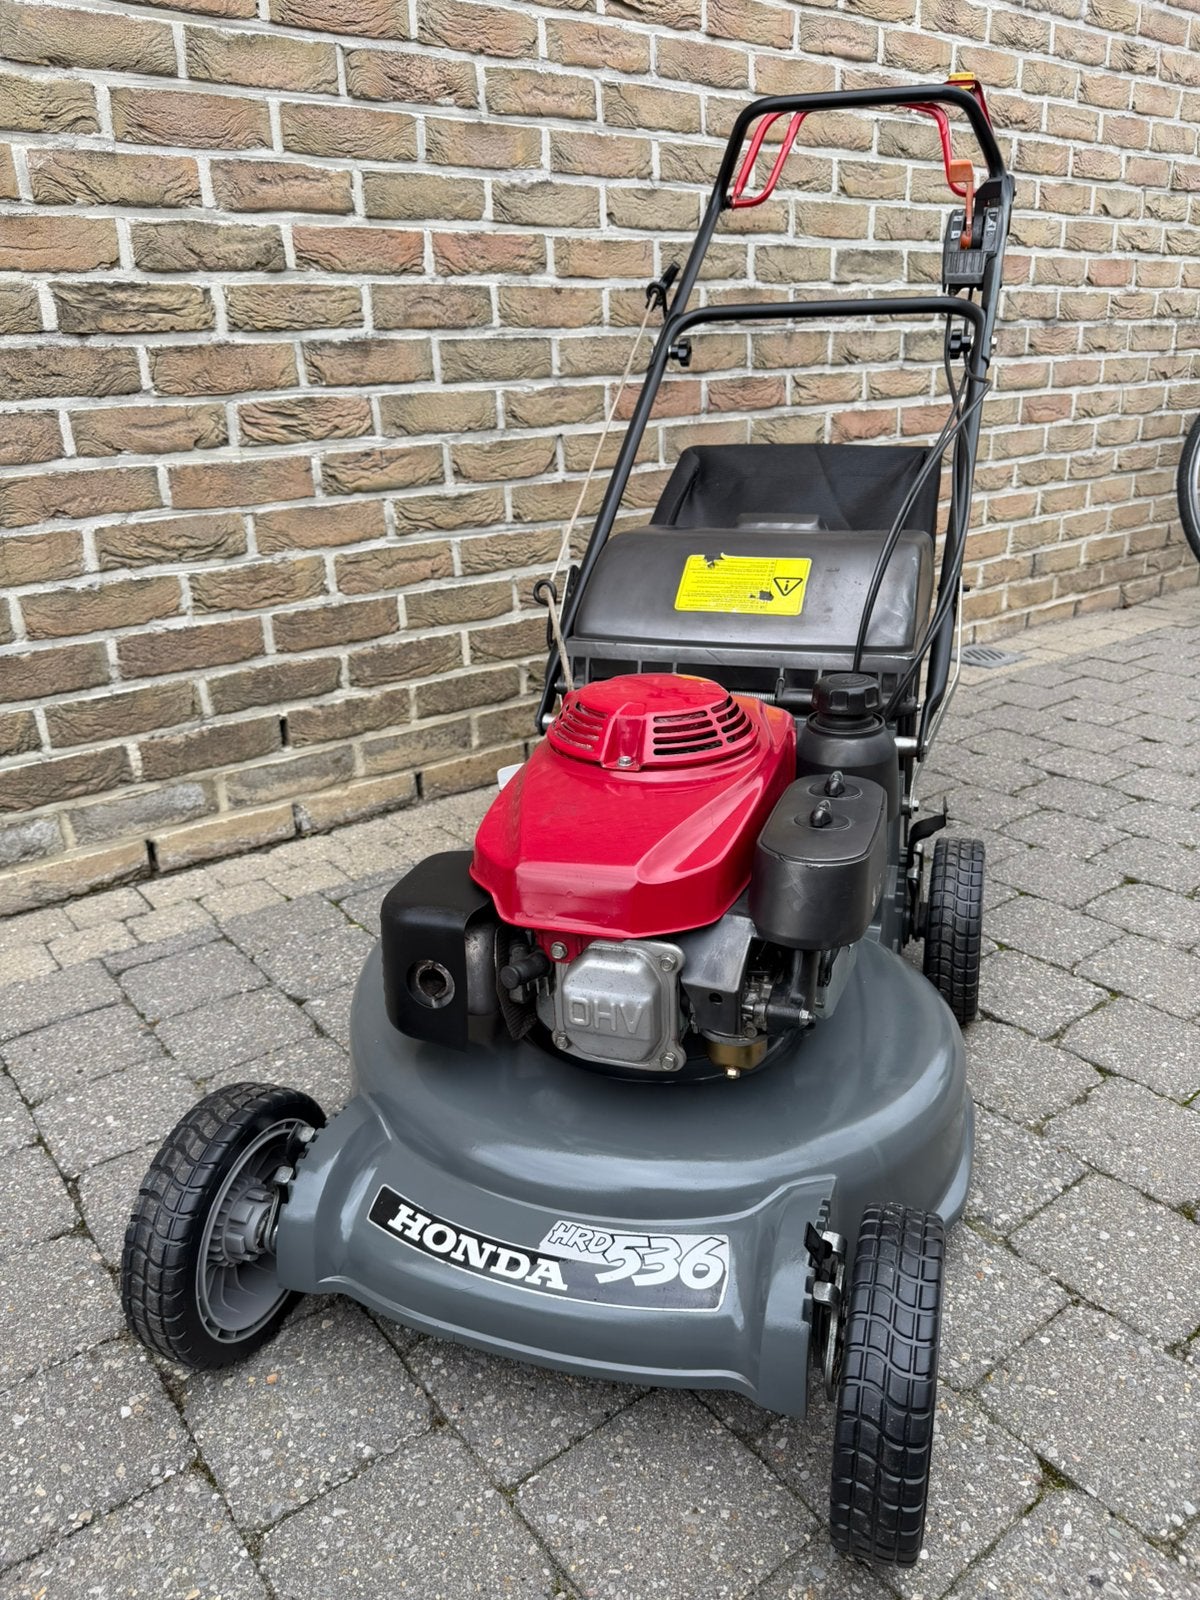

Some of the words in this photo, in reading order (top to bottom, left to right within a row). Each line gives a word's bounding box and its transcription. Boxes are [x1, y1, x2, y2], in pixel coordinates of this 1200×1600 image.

[567, 996, 645, 1035] OHV
[387, 1203, 568, 1291] HONDA
[548, 1222, 614, 1254] HRD
[595, 1234, 727, 1290] 536
